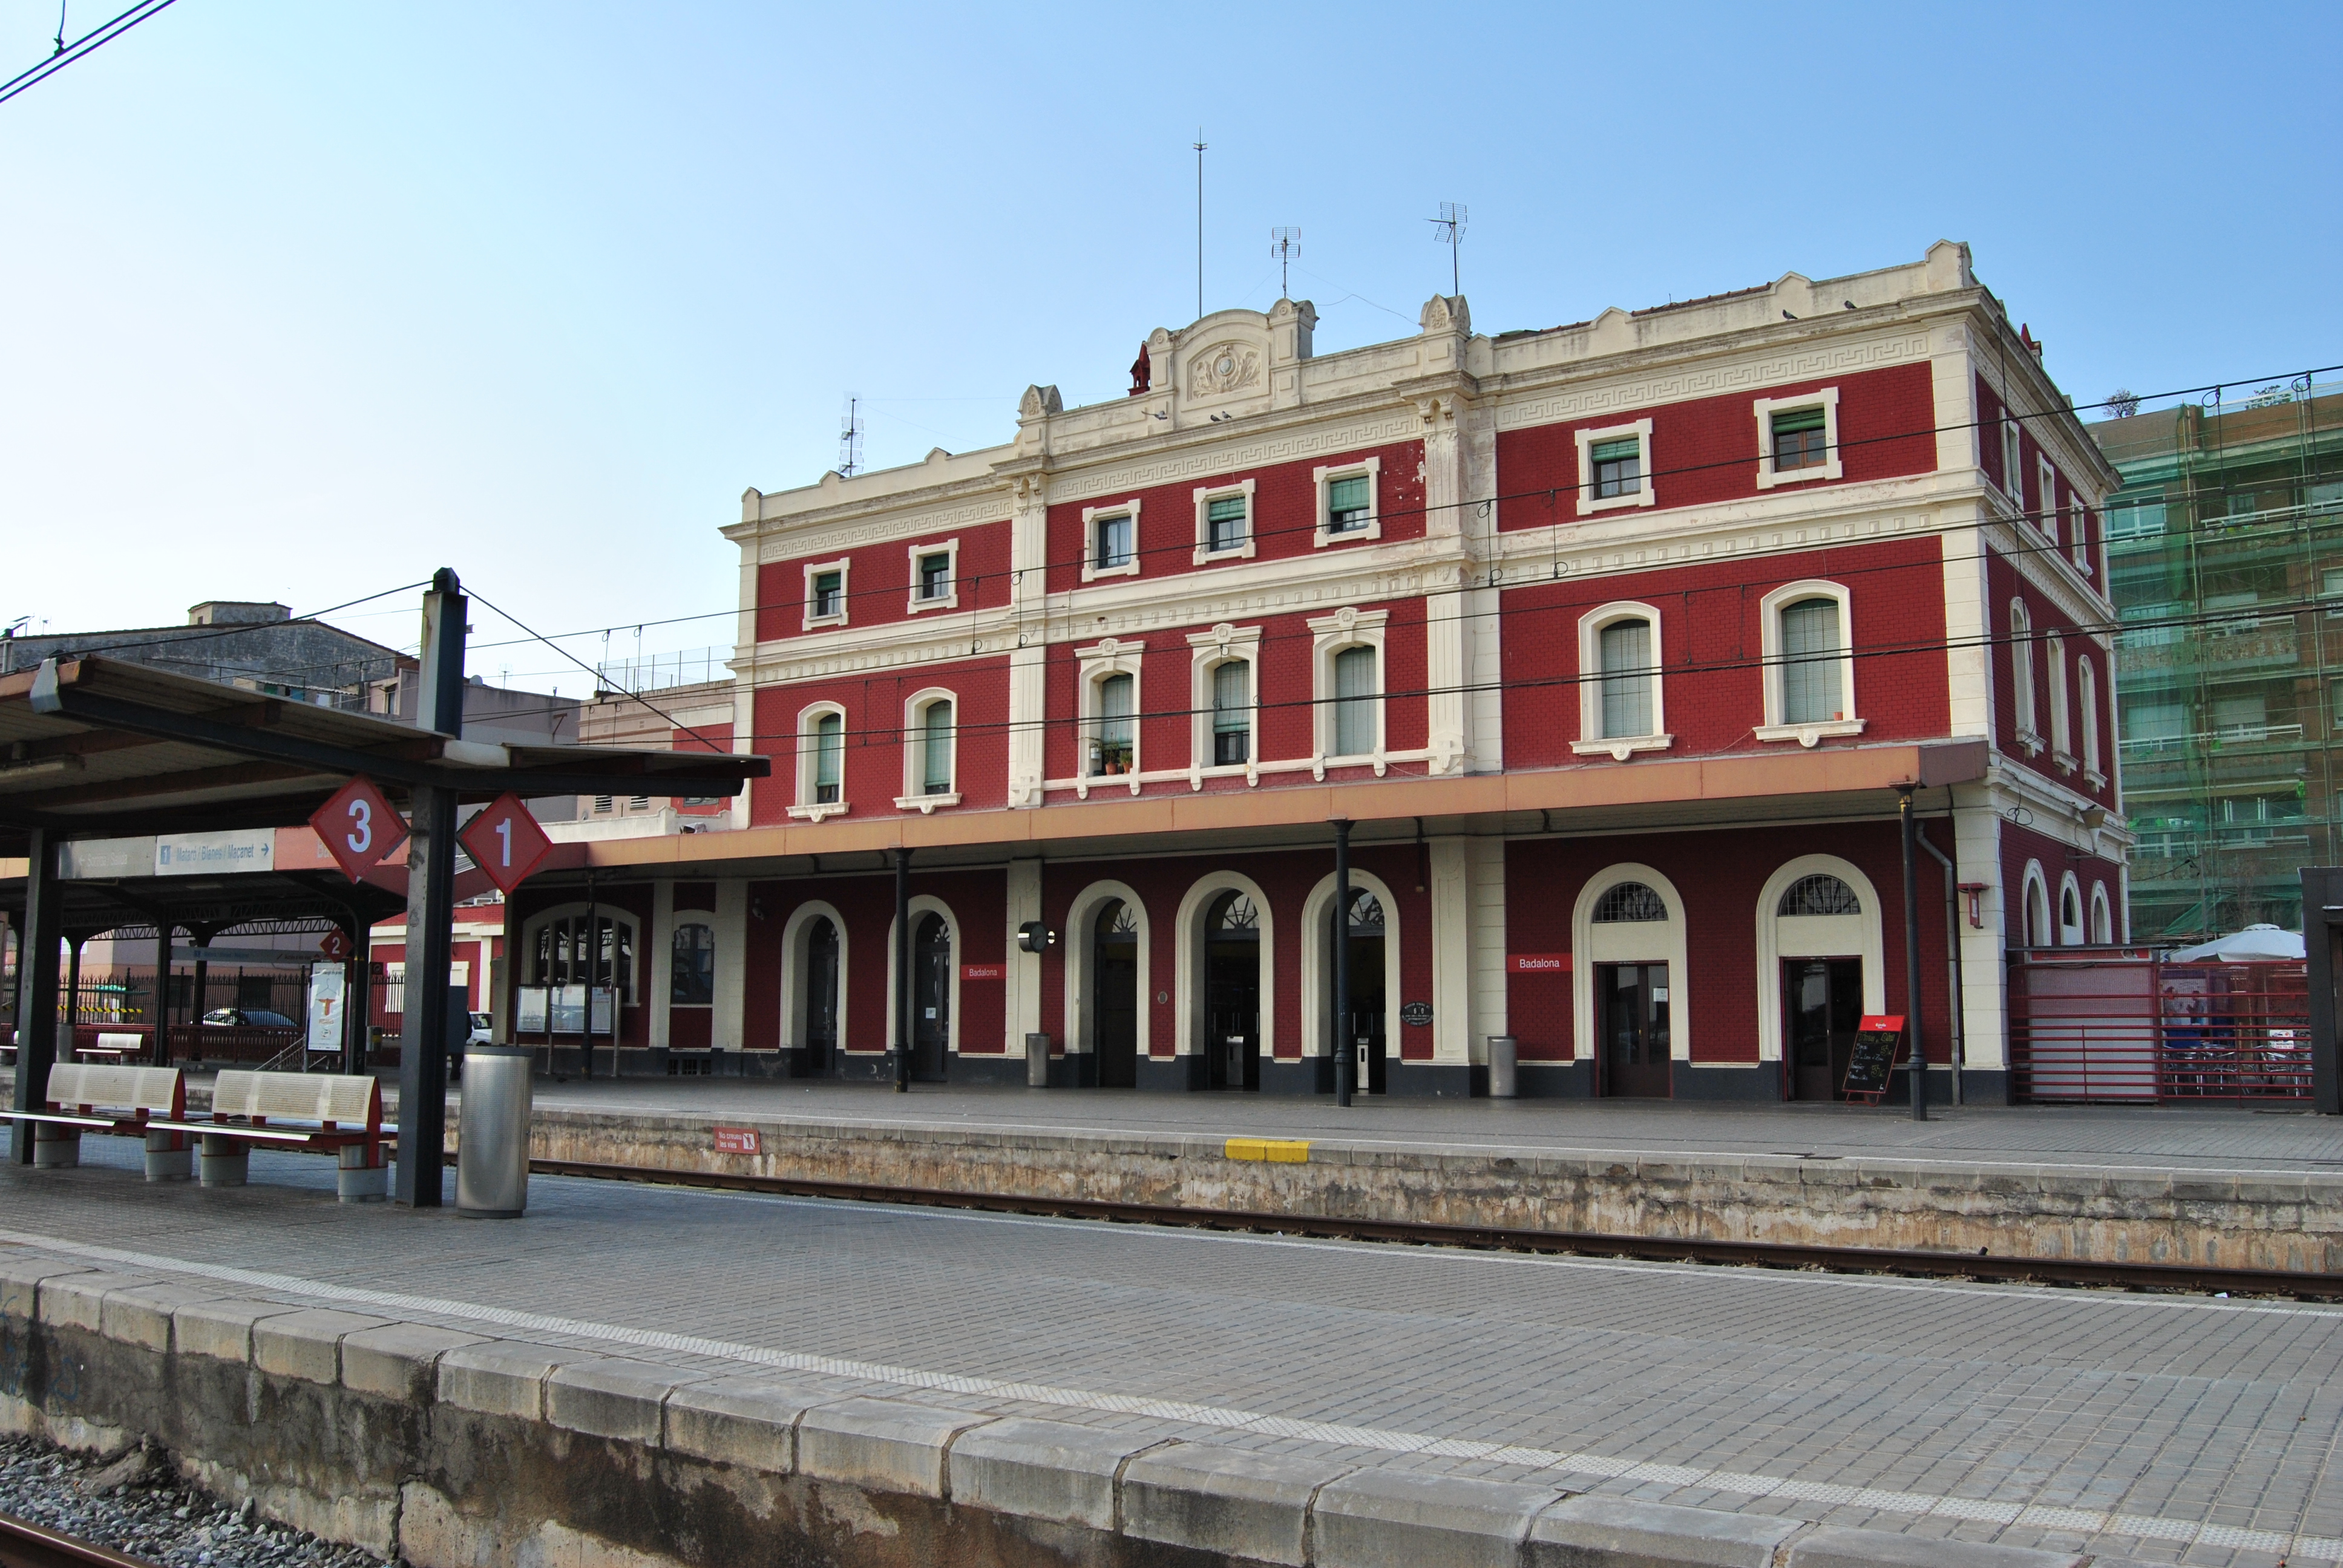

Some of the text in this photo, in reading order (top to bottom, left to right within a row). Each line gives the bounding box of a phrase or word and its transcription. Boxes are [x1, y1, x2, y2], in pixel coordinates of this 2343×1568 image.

[347, 799, 372, 853] 3
[496, 818, 511, 867] 1
[202, 844, 223, 861] Blanes
[228, 843, 254, 862] Maçanet
[332, 937, 341, 955] 2
[969, 968, 997, 976] Badalona
[1519, 958, 1560, 969] Badalona
